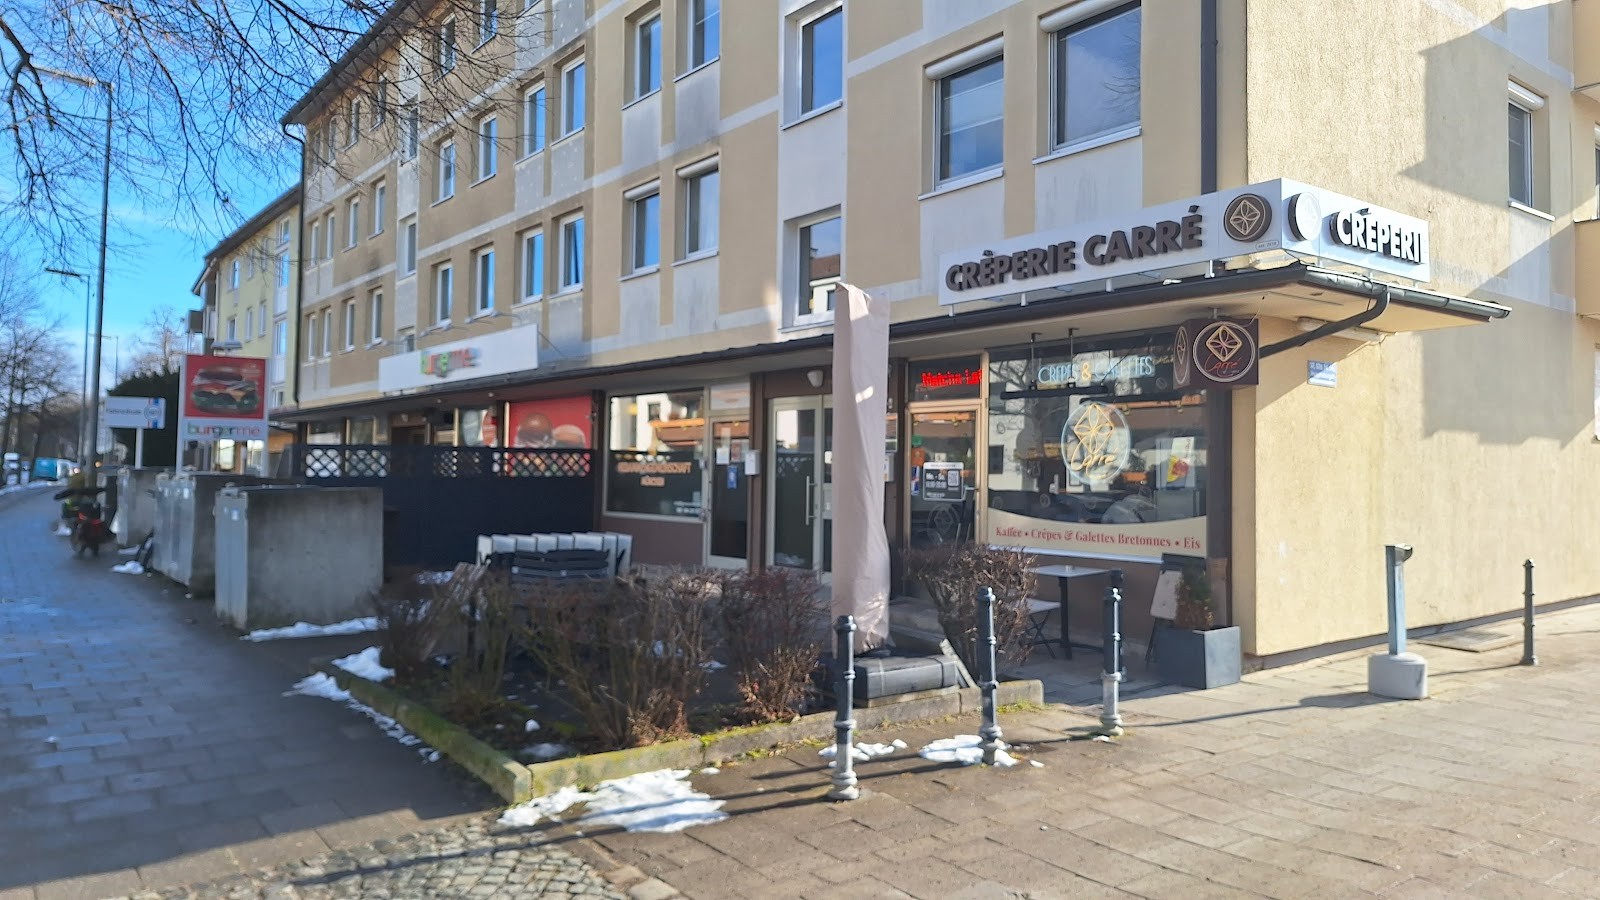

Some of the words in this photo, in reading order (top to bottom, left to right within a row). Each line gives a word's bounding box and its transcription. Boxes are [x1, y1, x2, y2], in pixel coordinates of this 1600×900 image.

[1083, 204, 1203, 266] CARRÉ
[1082, 362, 1092, 381] &
[995, 527, 1022, 538] Kaffee
[1064, 530, 1074, 541] &
[1075, 530, 1115, 544] Galettes
[1118, 533, 1171, 547] Bretonnes
[1183, 537, 1201, 550] Eis
